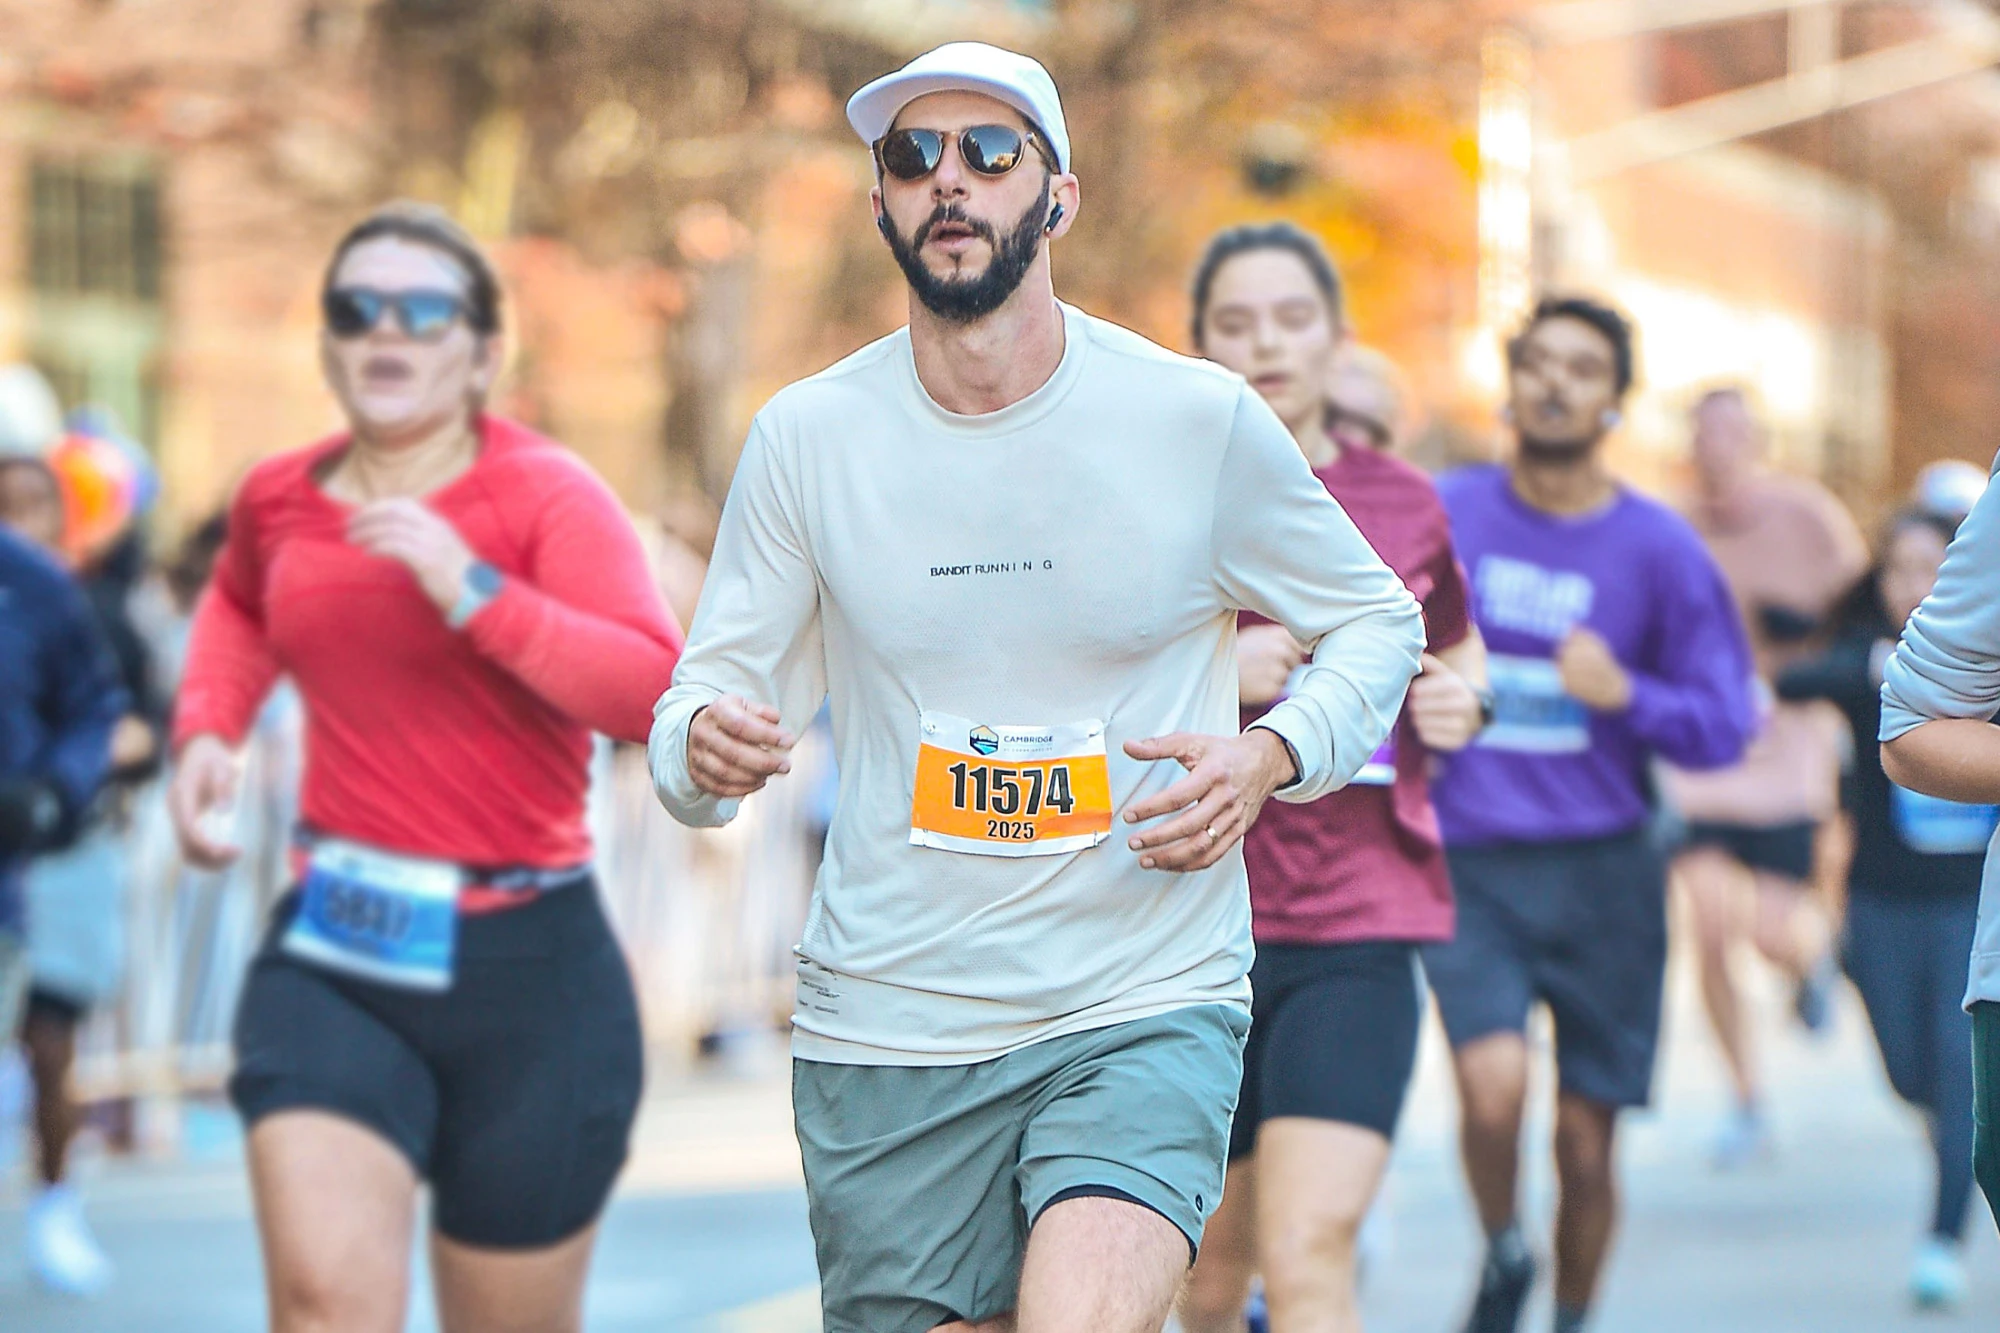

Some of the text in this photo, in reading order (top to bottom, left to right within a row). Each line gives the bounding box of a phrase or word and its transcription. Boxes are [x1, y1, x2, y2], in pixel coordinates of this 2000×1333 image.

[930, 560, 1053, 577] BANDIT RUNNING
[1003, 735, 1054, 744] CAMBRIDGE
[949, 763, 1073, 815] 11574
[987, 820, 1034, 839] 2025
